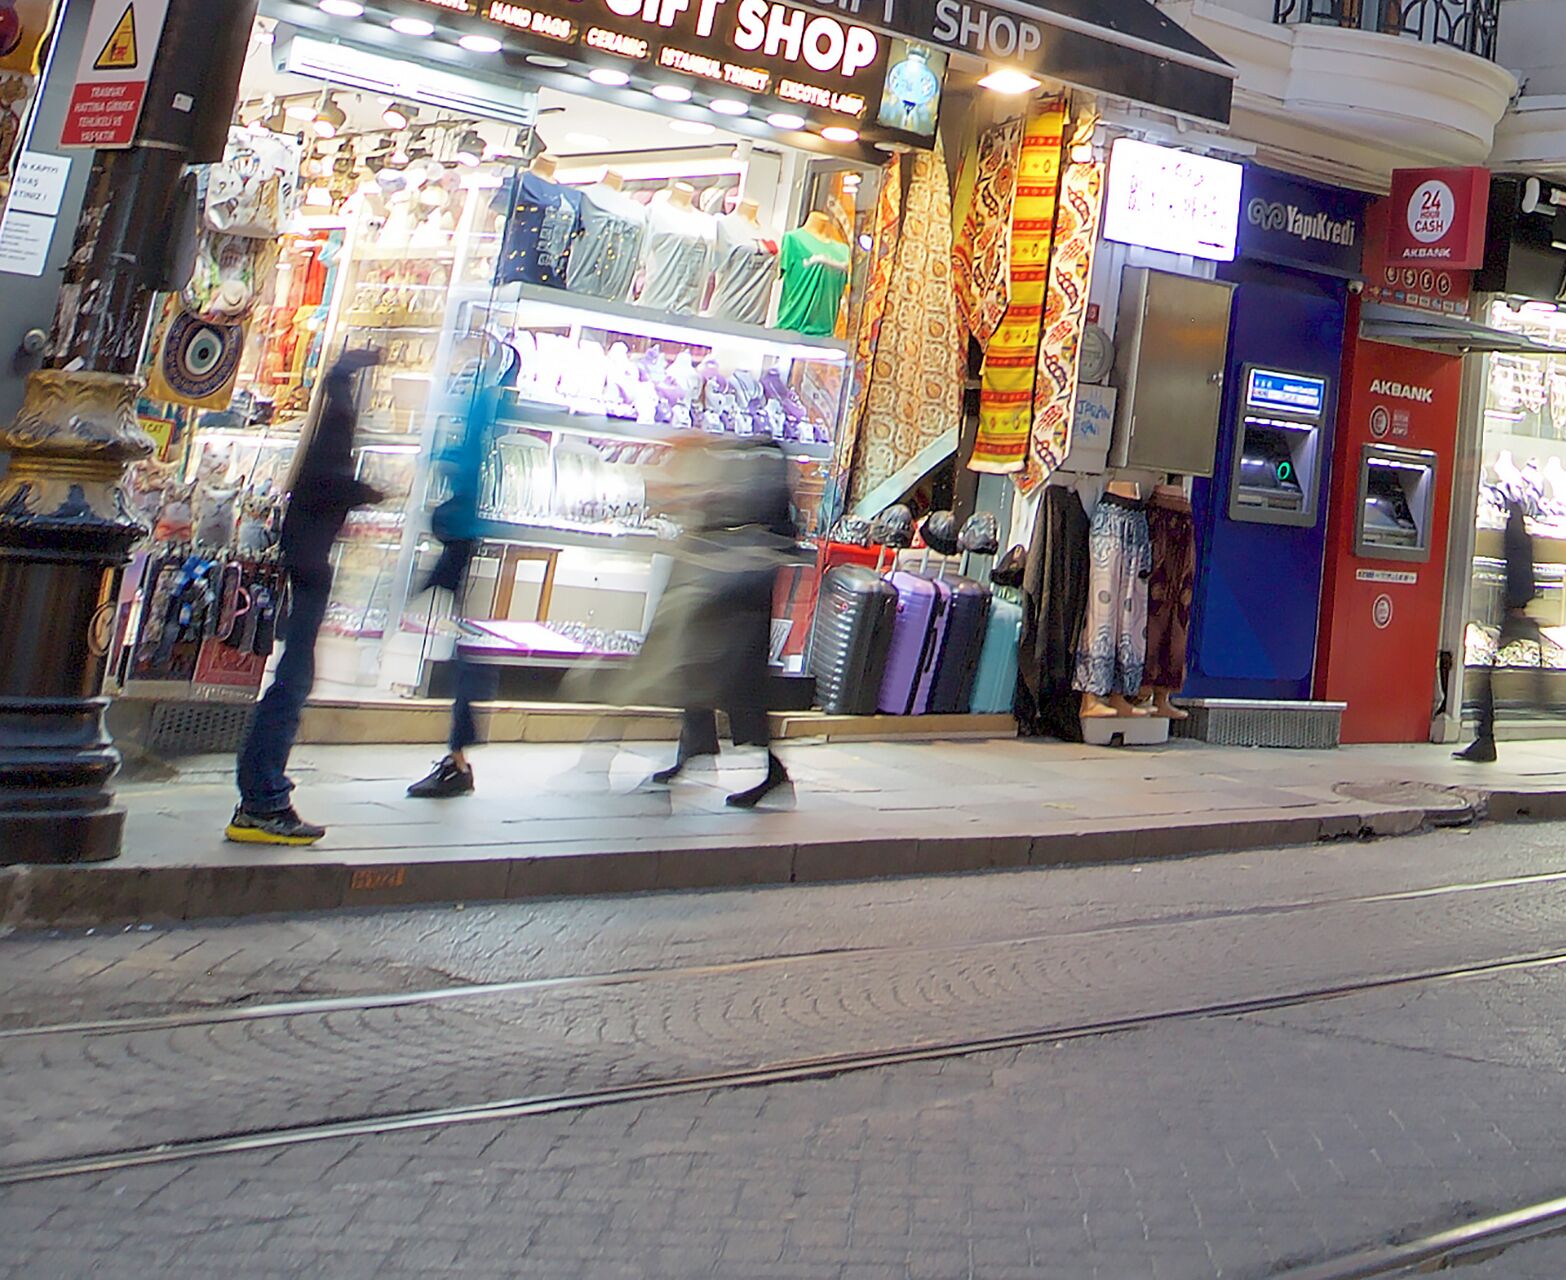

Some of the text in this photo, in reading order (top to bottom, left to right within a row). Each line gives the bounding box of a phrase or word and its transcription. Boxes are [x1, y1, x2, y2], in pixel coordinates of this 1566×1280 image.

[489, 0, 532, 28] HAND
[587, 27, 648, 58] CERAMIC
[660, 46, 722, 80] ISTANBUL
[1421, 190, 1441, 210] 24
[1414, 219, 1444, 233] CASH
[1402, 247, 1451, 259] AKBANK
[1370, 379, 1434, 404] AKBANK
